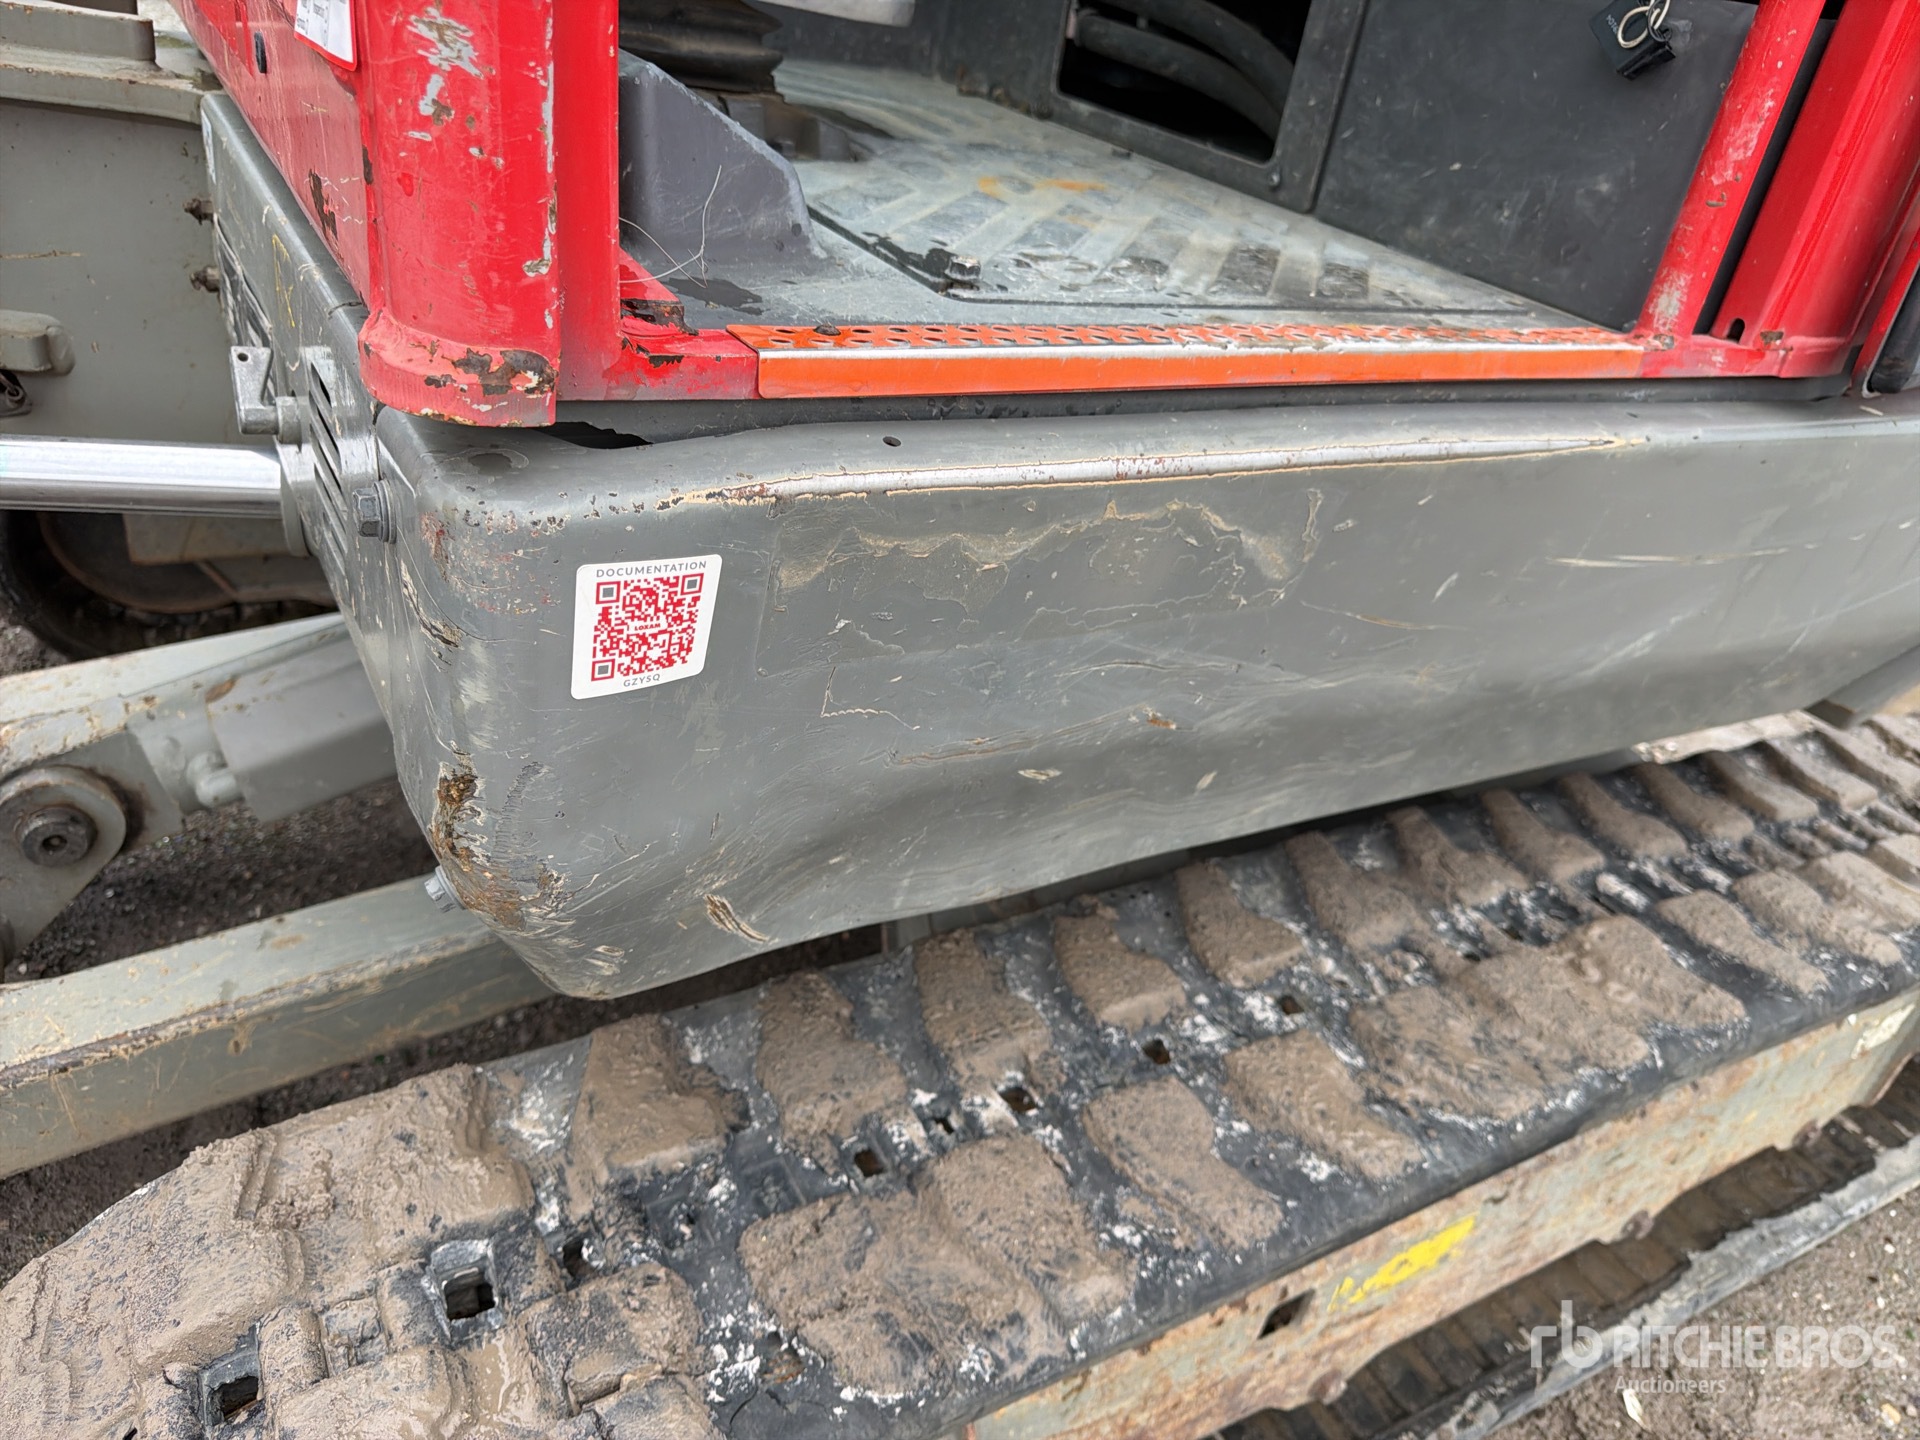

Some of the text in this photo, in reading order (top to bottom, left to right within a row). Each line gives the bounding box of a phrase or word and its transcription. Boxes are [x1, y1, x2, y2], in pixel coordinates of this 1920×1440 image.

[596, 561, 707, 578] DOCUMENTATION
[634, 623, 661, 631] LOXAM
[623, 673, 661, 687] GZYSQ
